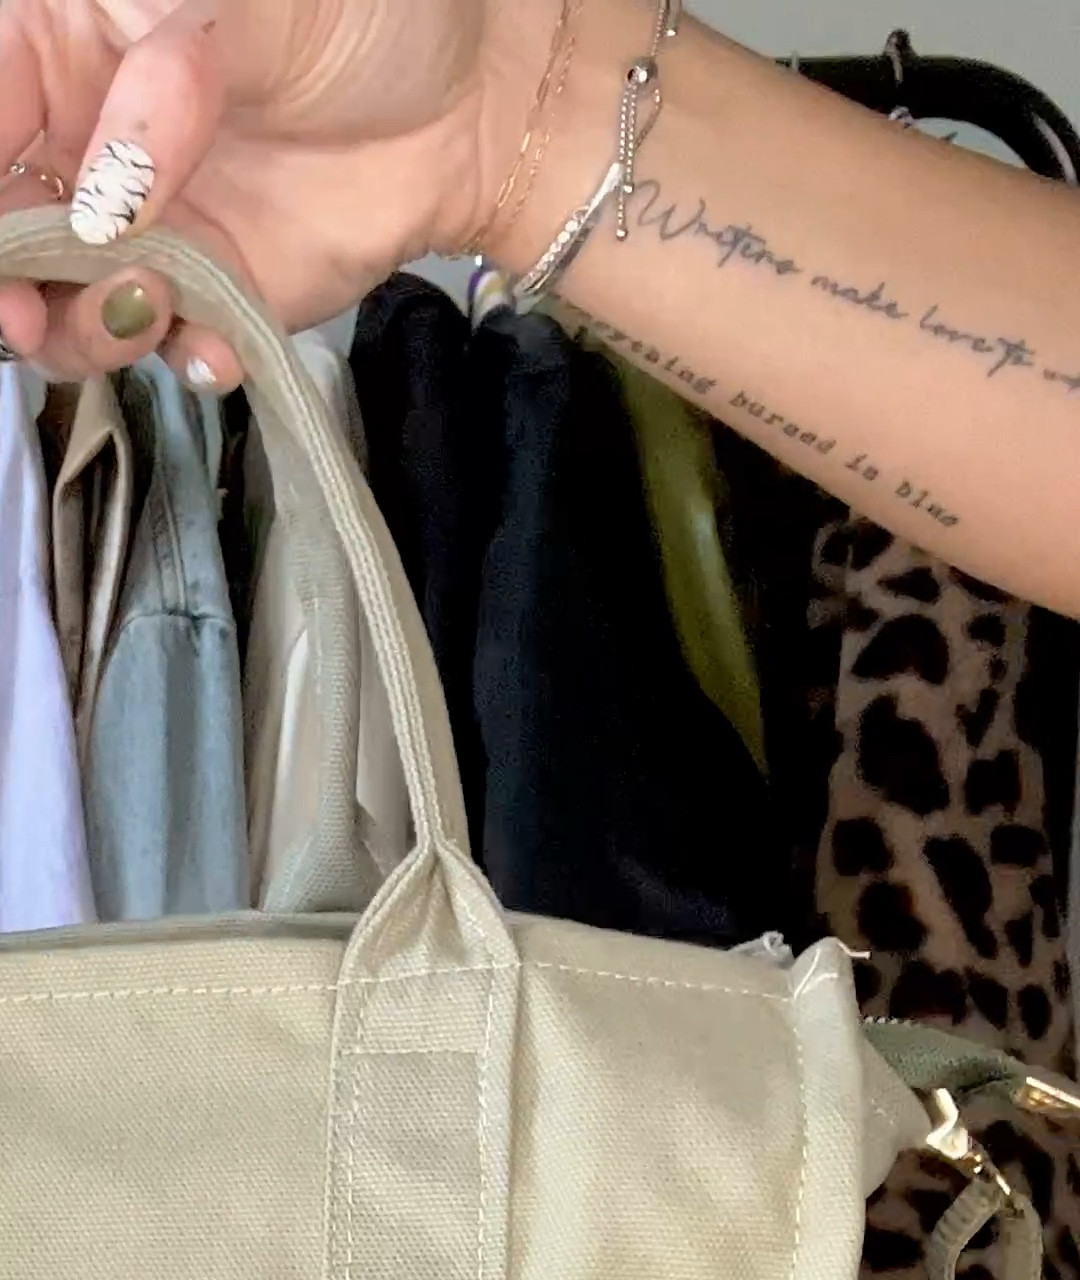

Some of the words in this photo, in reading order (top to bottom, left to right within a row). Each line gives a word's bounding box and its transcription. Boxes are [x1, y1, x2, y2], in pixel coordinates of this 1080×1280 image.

[634, 178, 803, 275] Writers
[810, 275, 909, 319] make
[919, 303, 994, 353] love
[844, 452, 880, 481] is
[894, 479, 961, 528] blue
